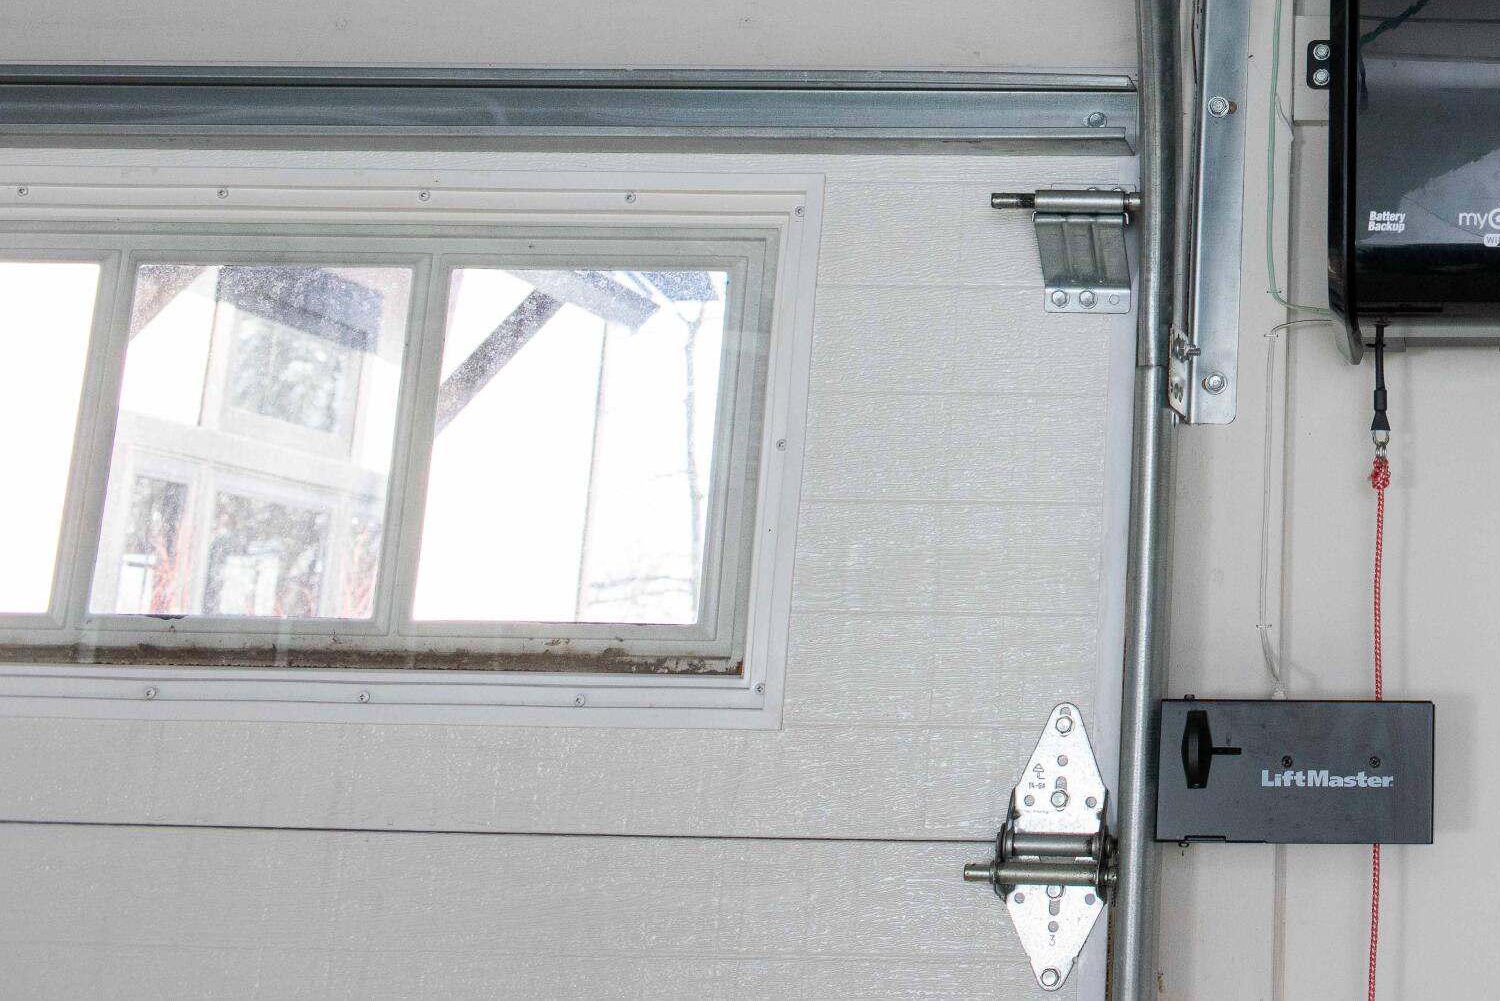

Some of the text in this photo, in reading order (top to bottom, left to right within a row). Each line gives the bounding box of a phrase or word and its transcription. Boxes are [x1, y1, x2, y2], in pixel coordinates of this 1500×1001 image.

[1369, 210, 1406, 222] Battery
[1368, 221, 1405, 233] Backup
[1261, 769, 1394, 788] LiftMaster
[1049, 934, 1056, 947] 3
